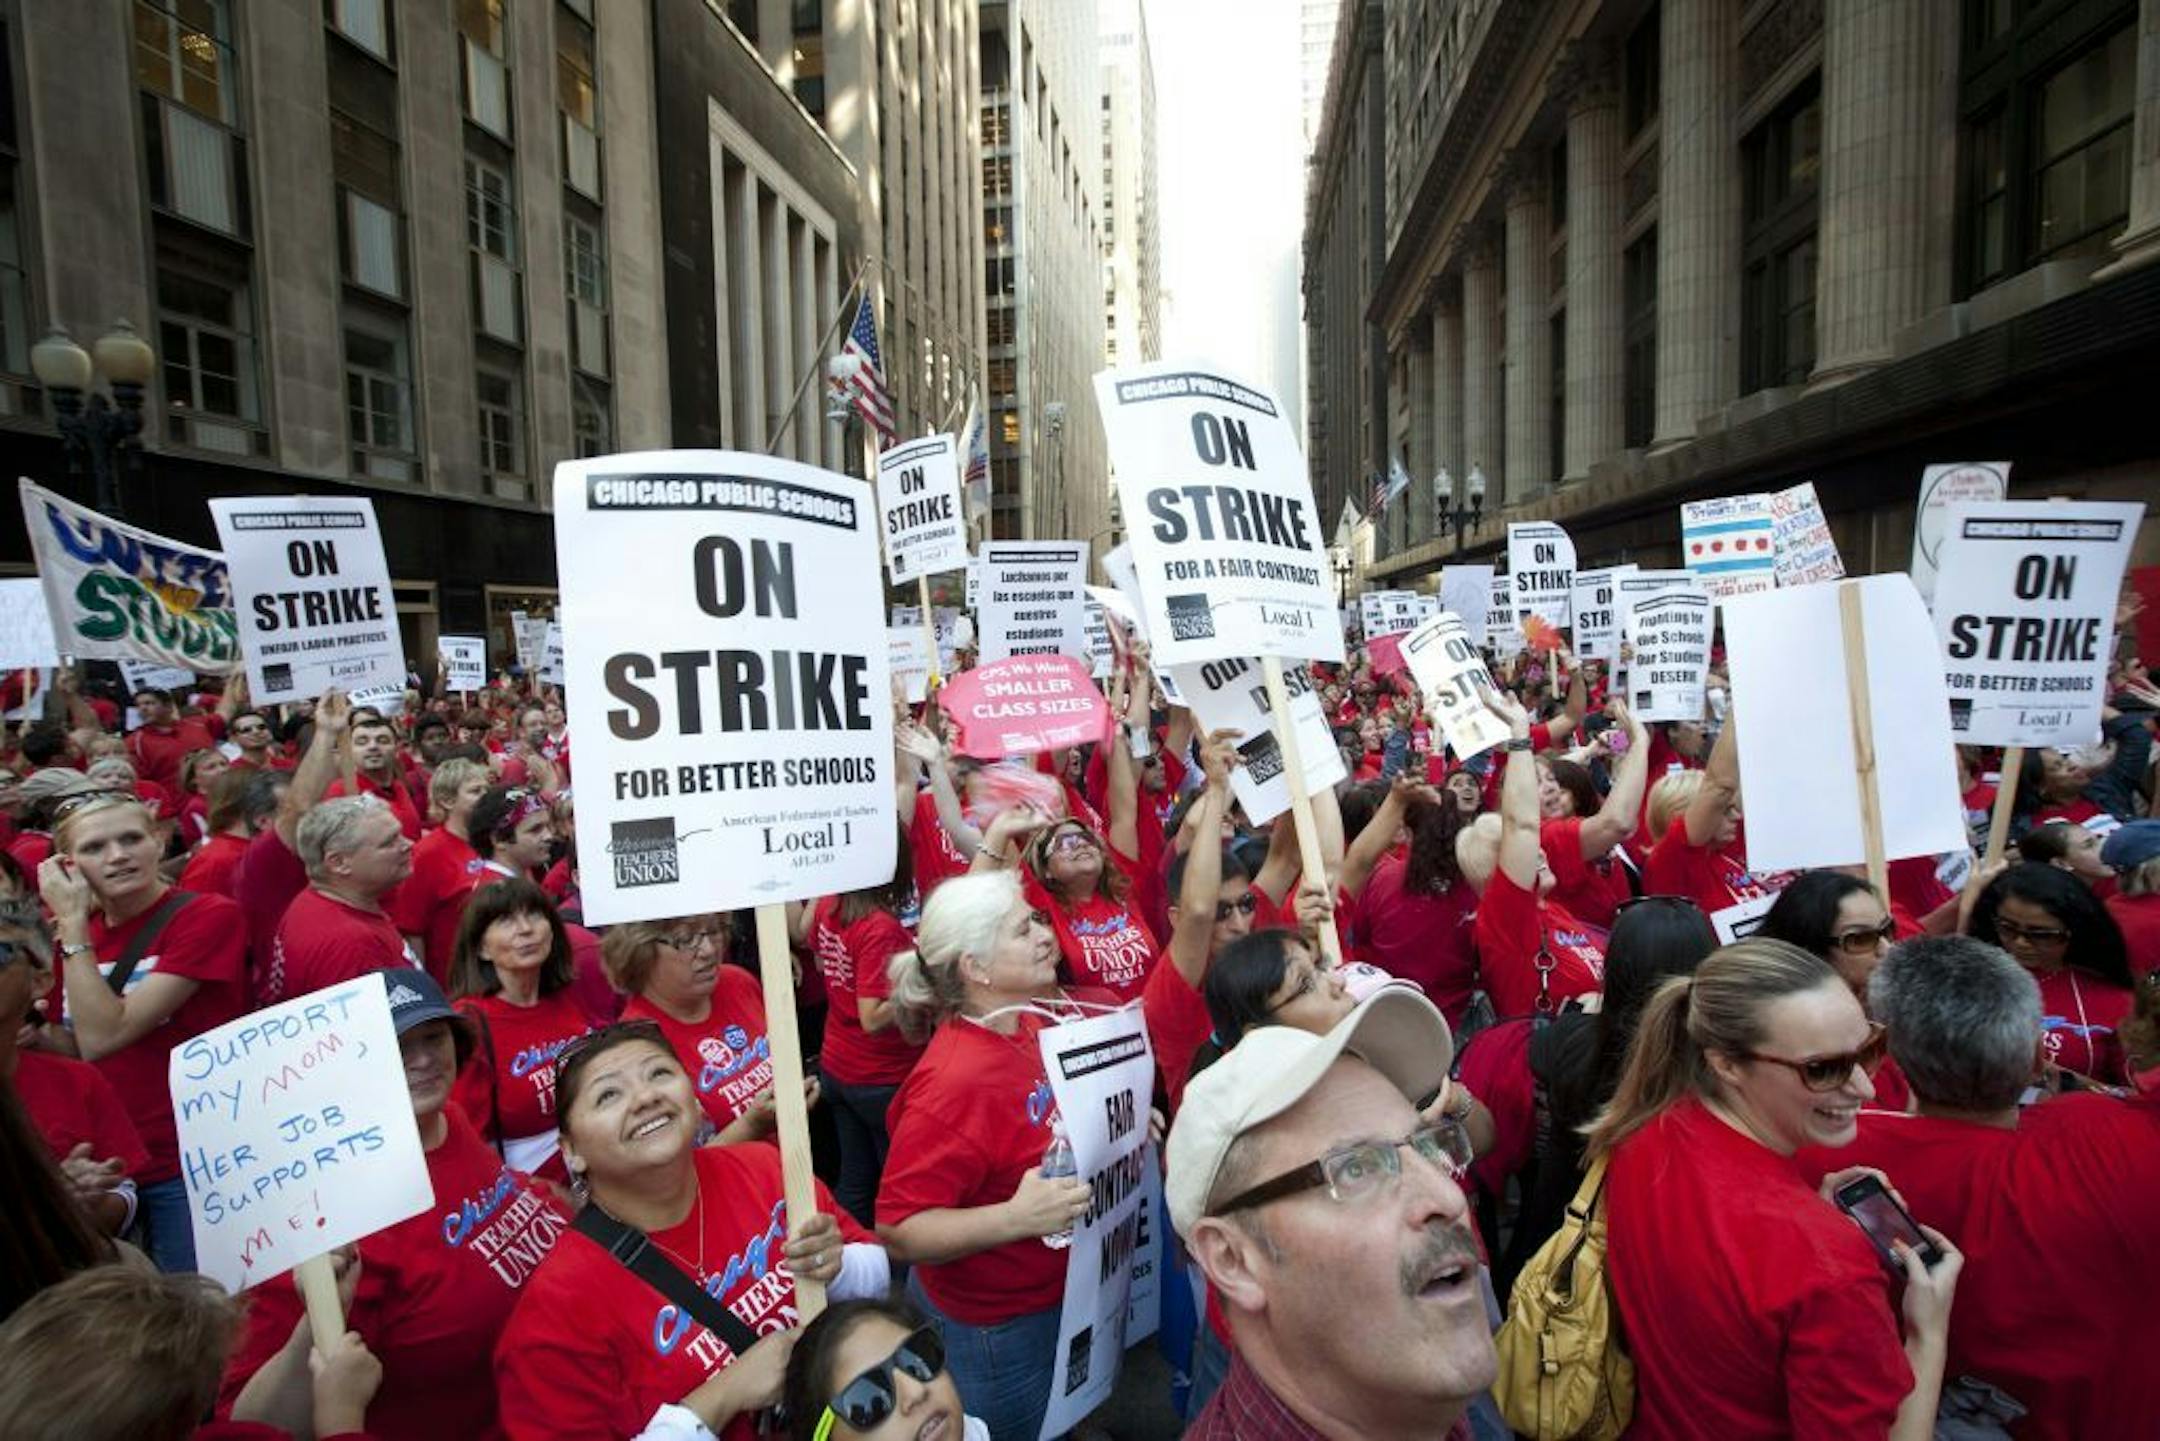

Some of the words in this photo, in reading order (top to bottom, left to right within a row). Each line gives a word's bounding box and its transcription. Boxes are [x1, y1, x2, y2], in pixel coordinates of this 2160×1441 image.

[1121, 378, 1188, 400] CHICAGO
[1191, 411, 1256, 471] ON
[900, 465, 925, 495] ON
[594, 480, 697, 506] CHICAGO
[701, 481, 777, 509] PUBLIC
[778, 488, 854, 524] SCHOOLS
[888, 493, 953, 534] STRIKE
[1147, 486, 1312, 551] STRIKE
[286, 540, 338, 579] ON
[1535, 543, 1555, 563] ON
[693, 535, 798, 620] ON
[1164, 560, 1200, 580] FOR
[1204, 559, 1216, 578] A
[1219, 559, 1254, 577] FAIR
[1257, 560, 1320, 586] CONTRACT
[1517, 569, 1572, 591] STRIKE
[2014, 554, 2077, 601] ON
[253, 586, 383, 632] STRIKE
[993, 590, 1008, 602] las
[1261, 605, 1304, 628] Local
[1948, 614, 2101, 662] STRIKE
[1012, 662, 1033, 676] We
[1035, 661, 1070, 675] Want
[1979, 674, 2038, 692] BETTER
[2041, 676, 2094, 692] SCHOOLS
[604, 649, 872, 743] STRIKE
[983, 679, 1074, 698] SMALLER
[972, 701, 1037, 719] CLASS
[1040, 697, 1094, 714] SIZES
[2018, 711, 2063, 727] Local
[614, 770, 670, 801] FOR
[678, 760, 778, 796] BETTER
[783, 756, 877, 788] SCHOOLS
[721, 813, 778, 829] American
[763, 822, 834, 855] Local
[843, 821, 853, 846] 1
[614, 850, 677, 868] TEACHERS
[615, 861, 679, 887] UNION
[1083, 938, 1152, 972] UNION
[183, 991, 361, 1081] SUPPORT
[1105, 1088, 1135, 1144] FAIR
[184, 1144, 257, 1193] HER
[278, 1105, 346, 1143] JOB
[202, 1125, 386, 1226] SUPPORTS
[488, 1200, 569, 1289] UNION
